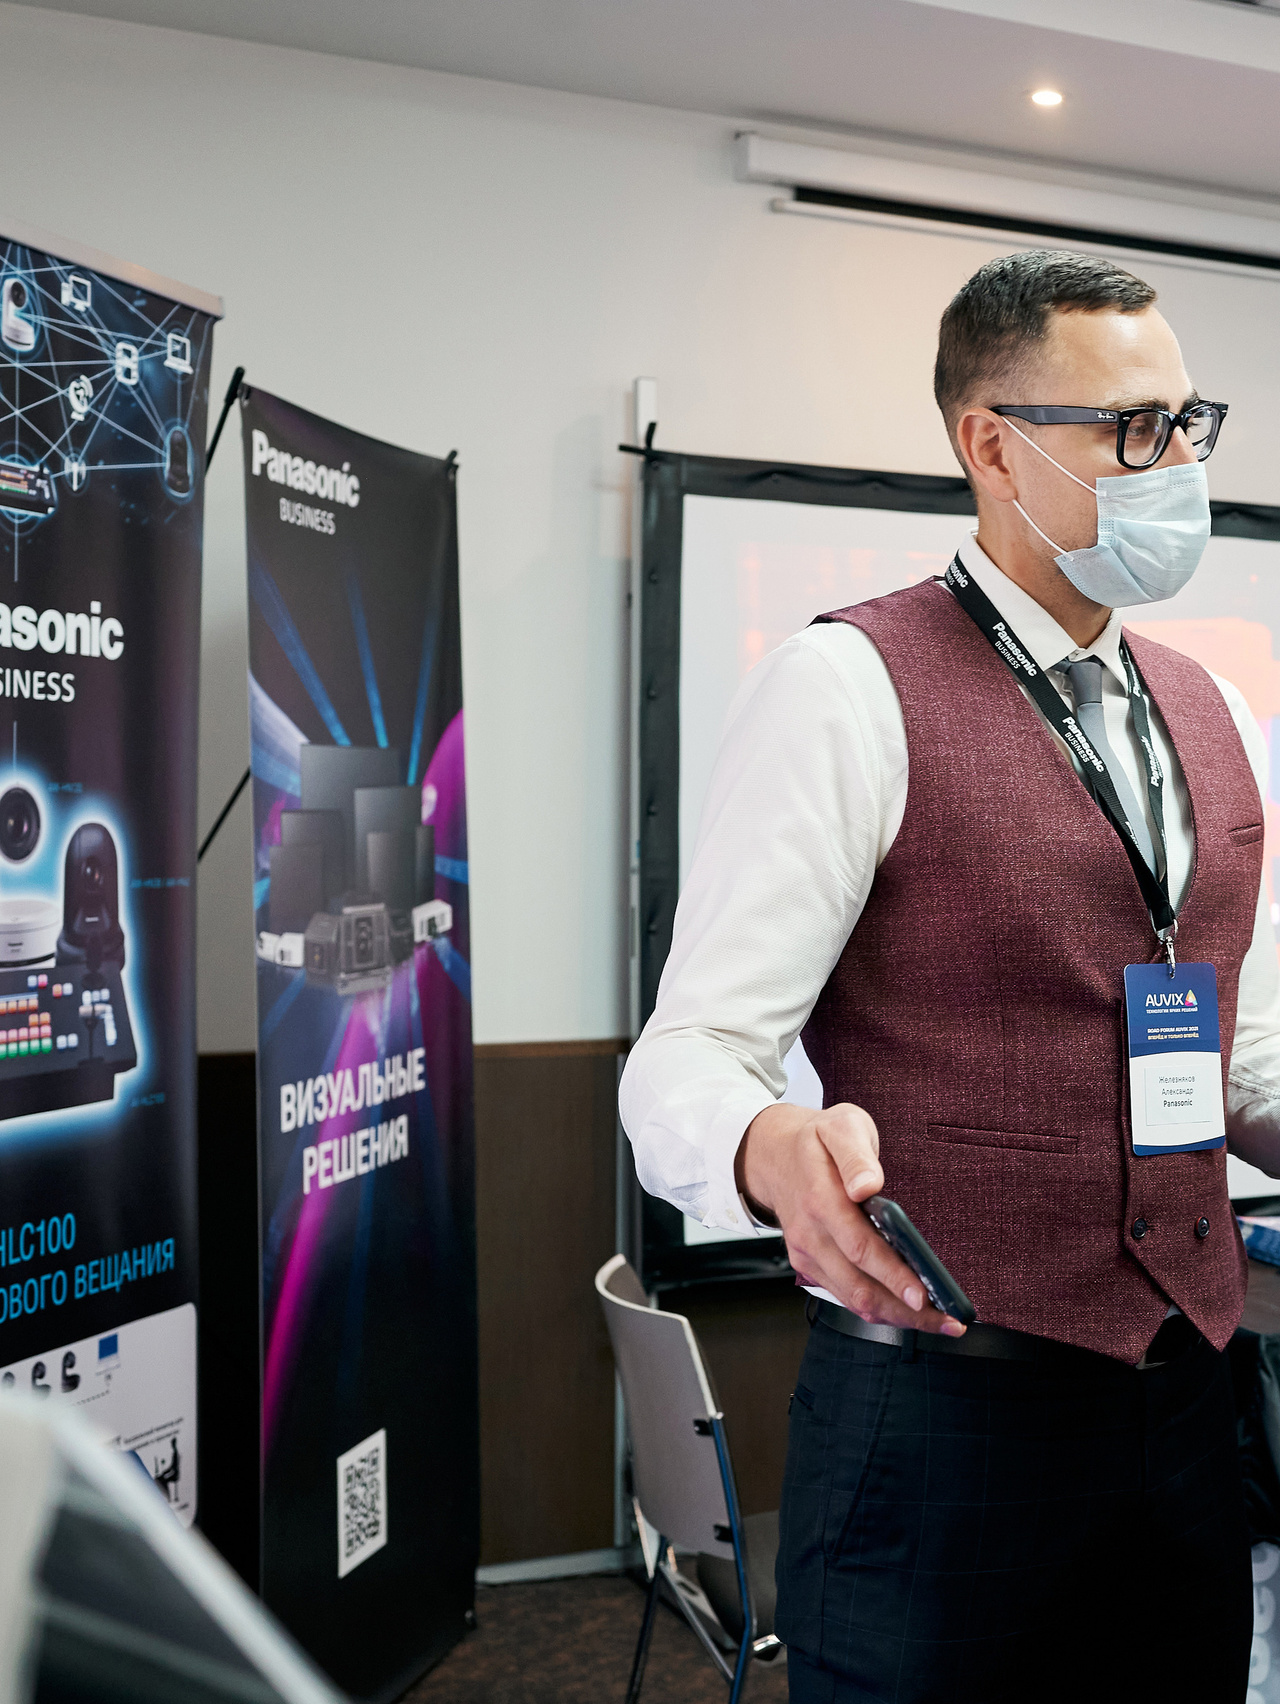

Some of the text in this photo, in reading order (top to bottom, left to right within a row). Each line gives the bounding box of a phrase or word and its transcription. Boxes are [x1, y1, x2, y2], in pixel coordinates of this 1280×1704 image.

[252, 428, 360, 508] Panasonic
[279, 497, 336, 536] BUSINESS
[992, 621, 1038, 677] Panasonic
[994, 640, 1021, 669] BUSINESS
[0, 667, 76, 703] INESS
[1062, 716, 1104, 773] Panasonic
[1064, 731, 1090, 763] BUSINESS
[1145, 993, 1184, 1007] AUVIX
[280, 1046, 426, 1133] ВИЗУАЛЬНЫЕ
[1159, 1076, 1195, 1084] Железняков
[1161, 1088, 1194, 1096] Александр
[1163, 1098, 1193, 1107] Panasonic
[303, 1113, 409, 1195] РЕШЕНИЯ
[74, 1237, 175, 1300] ВЕЩАНИЯ
